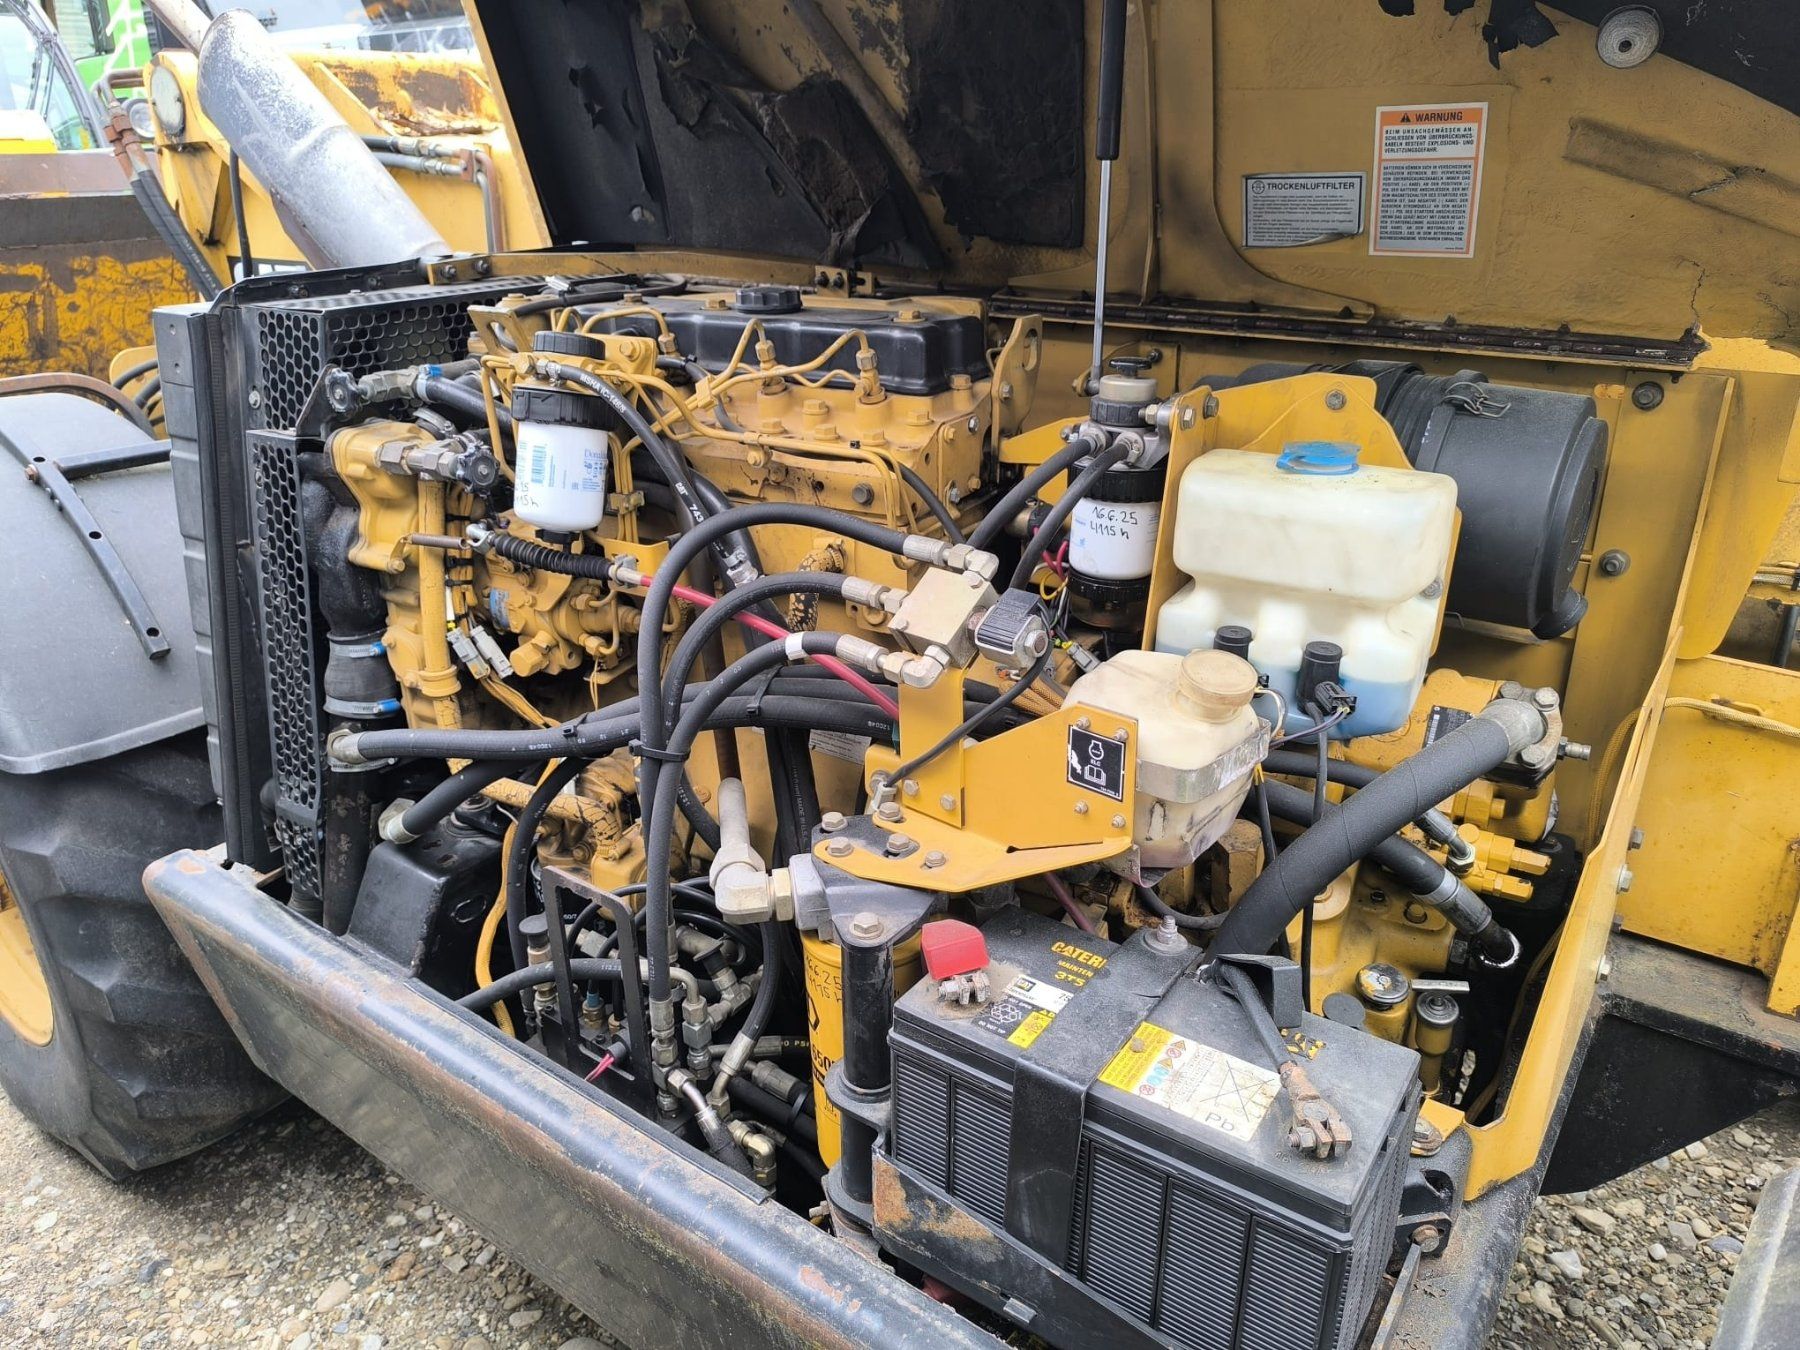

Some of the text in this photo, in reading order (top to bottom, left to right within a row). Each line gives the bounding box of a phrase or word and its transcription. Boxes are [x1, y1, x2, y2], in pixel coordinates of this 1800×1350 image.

[1415, 112, 1463, 122] WARNUNG
[1267, 182, 1355, 190] TROCKENLUFTFILTER
[579, 373, 601, 392] MSHA
[675, 482, 690, 497] CAT
[1092, 506, 1138, 526] 16.6.25
[1120, 528, 1130, 540] h
[1090, 758, 1102, 767] ELC
[1051, 941, 1108, 969] CATER
[1205, 1112, 1235, 1132] Pb
